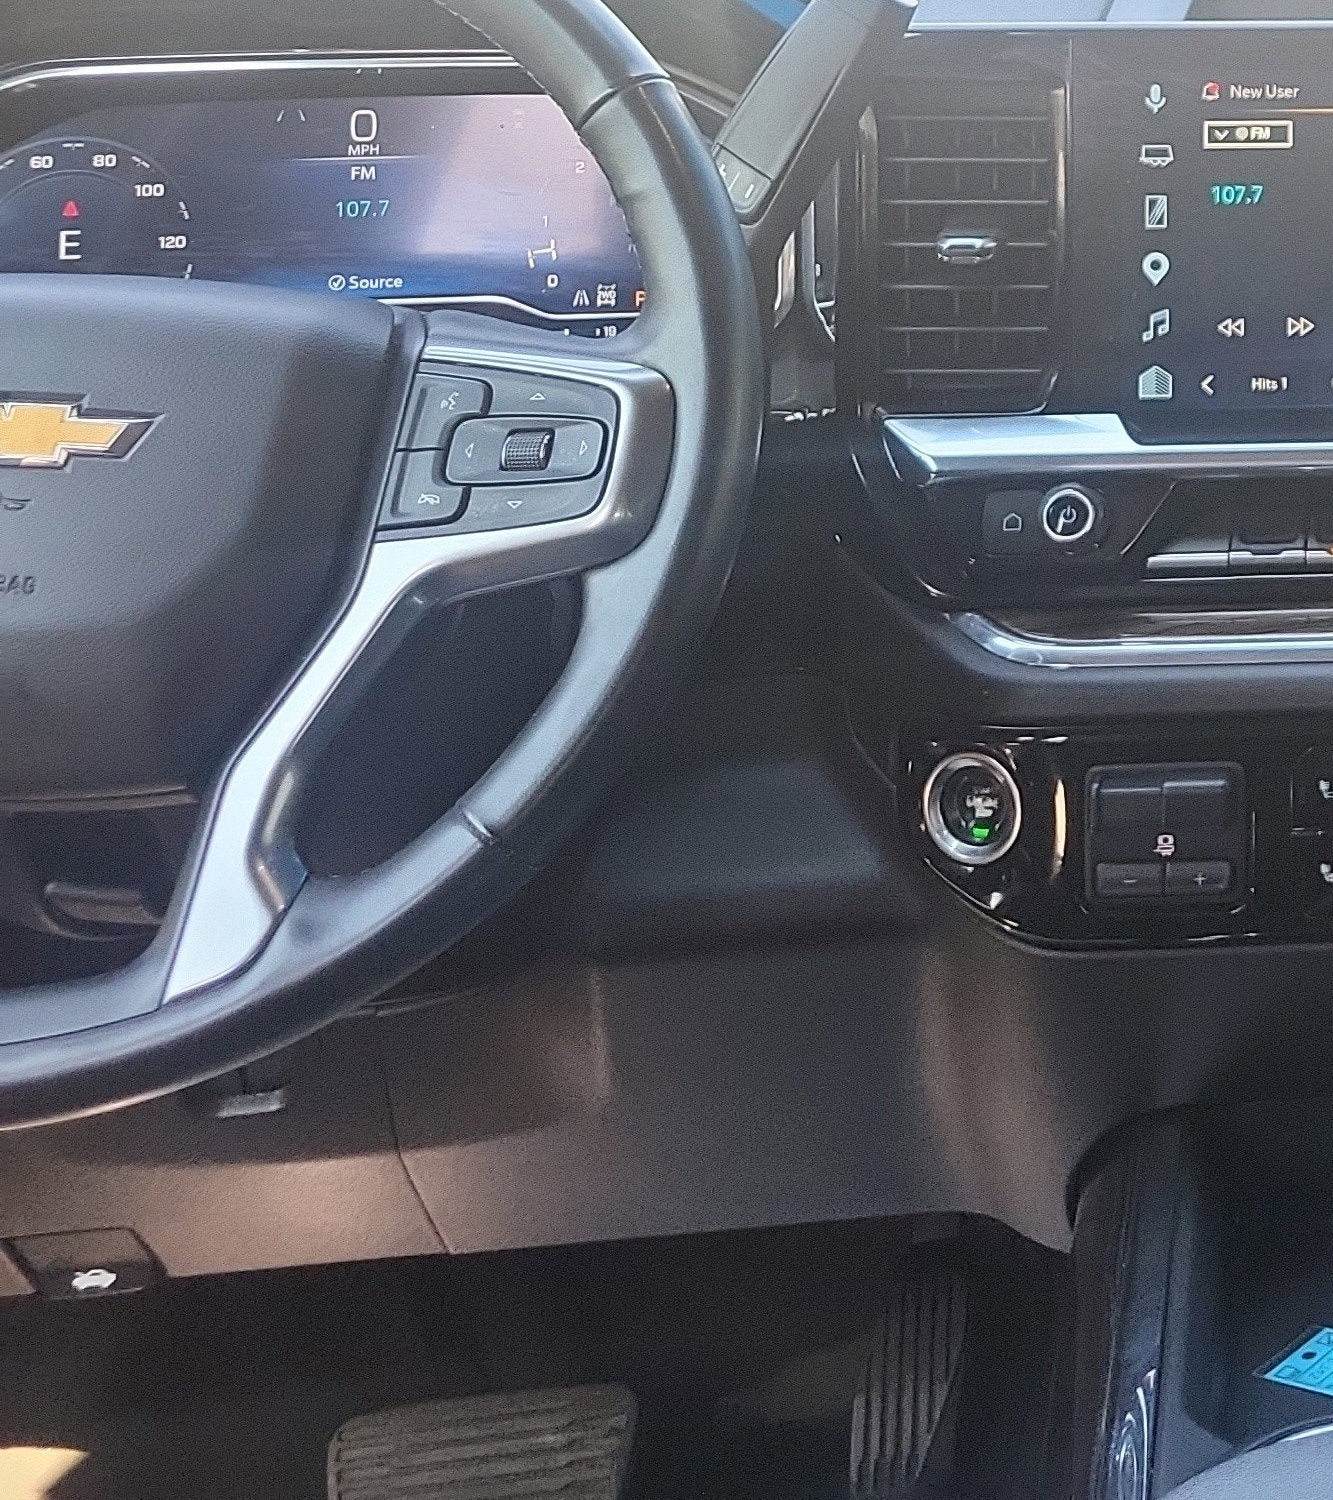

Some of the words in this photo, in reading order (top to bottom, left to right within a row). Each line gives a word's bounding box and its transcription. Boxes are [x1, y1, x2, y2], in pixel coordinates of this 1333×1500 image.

[1230, 84, 1262, 99] New
[1266, 84, 1300, 99] User
[350, 109, 377, 142] 0
[1249, 126, 1271, 140] FM
[347, 143, 380, 156] MPH
[29, 155, 54, 169] 60
[92, 154, 117, 167] 80
[575, 161, 585, 173] 2
[350, 165, 376, 181] FM
[134, 183, 165, 197] 100
[1211, 184, 1263, 205] 107.7
[336, 200, 390, 218] 107.7
[59, 230, 82, 260] E
[158, 235, 187, 249] 120
[349, 275, 403, 289] Source
[547, 274, 559, 288] 0
[1251, 377, 1278, 392] Hits
